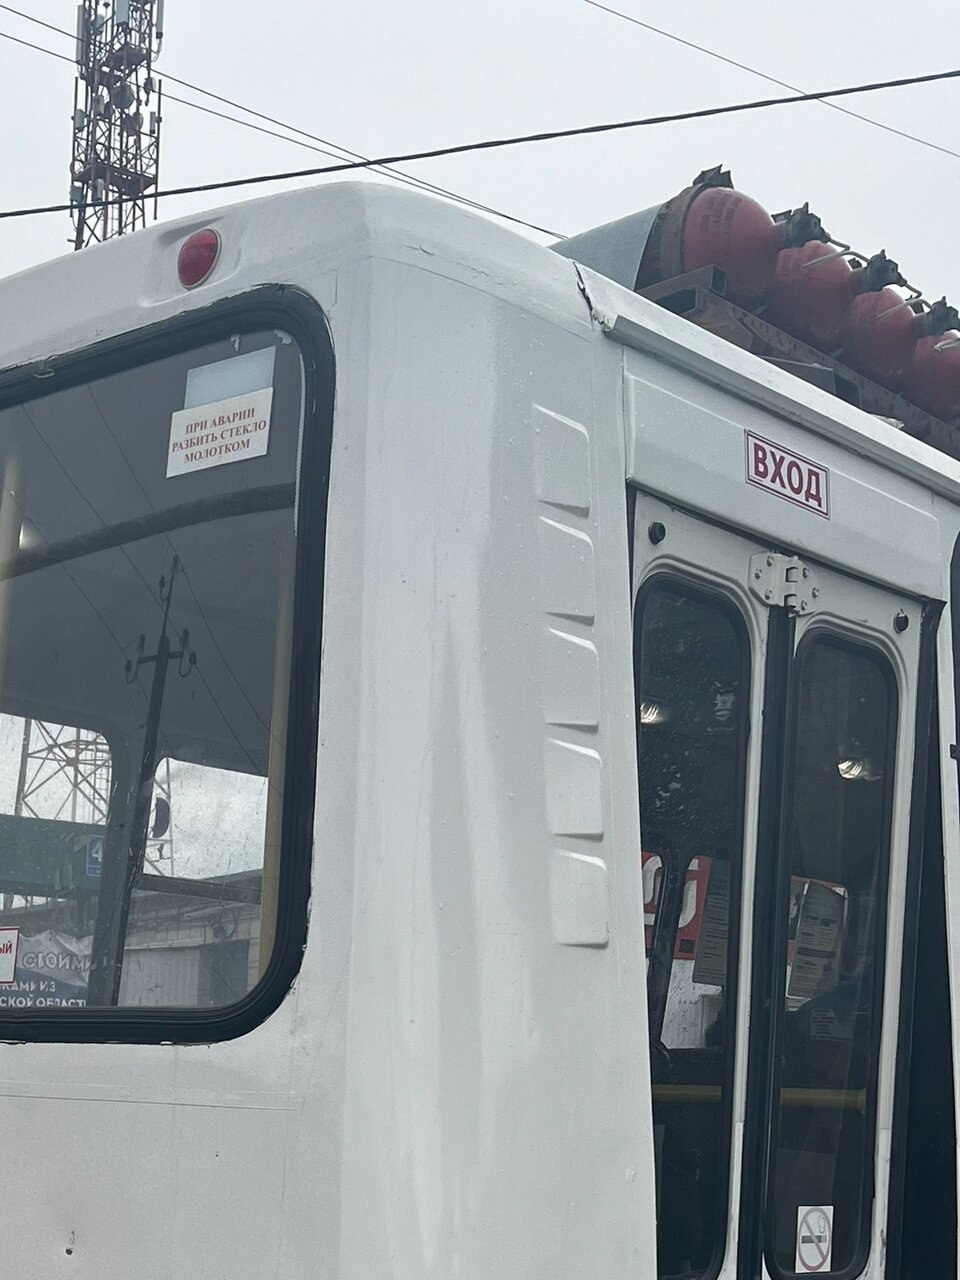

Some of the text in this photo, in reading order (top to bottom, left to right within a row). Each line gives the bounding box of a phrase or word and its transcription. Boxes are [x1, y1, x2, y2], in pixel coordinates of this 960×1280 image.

[171, 420, 267, 453] РАЗБИТЬ СТЕКЛО
[185, 408, 256, 435] ПРИ АВАРИИ
[184, 438, 251, 464] МОЛОТКОМ
[753, 442, 822, 508] ВХОД
